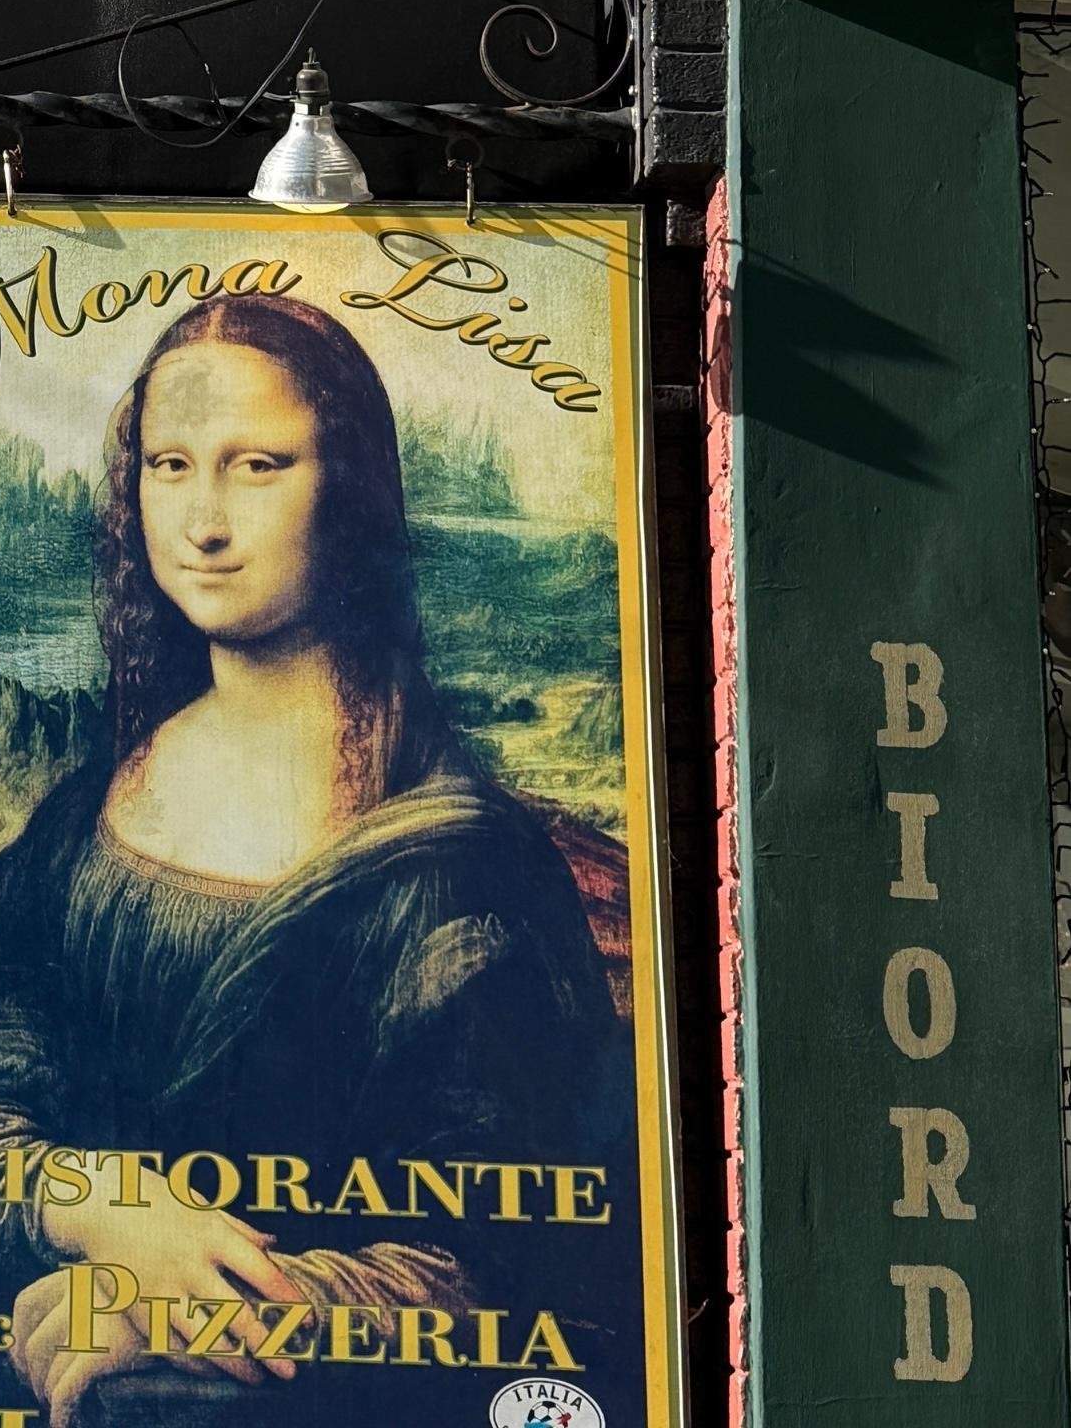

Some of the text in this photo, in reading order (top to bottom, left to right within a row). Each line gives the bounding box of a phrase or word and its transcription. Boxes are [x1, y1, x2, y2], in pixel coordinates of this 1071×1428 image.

[339, 227, 602, 413] Lisa
[870, 640, 977, 1383] BIORD
[54, 1262, 587, 1372] PIZZERIA
[512, 1384, 583, 1412] ITALIA
